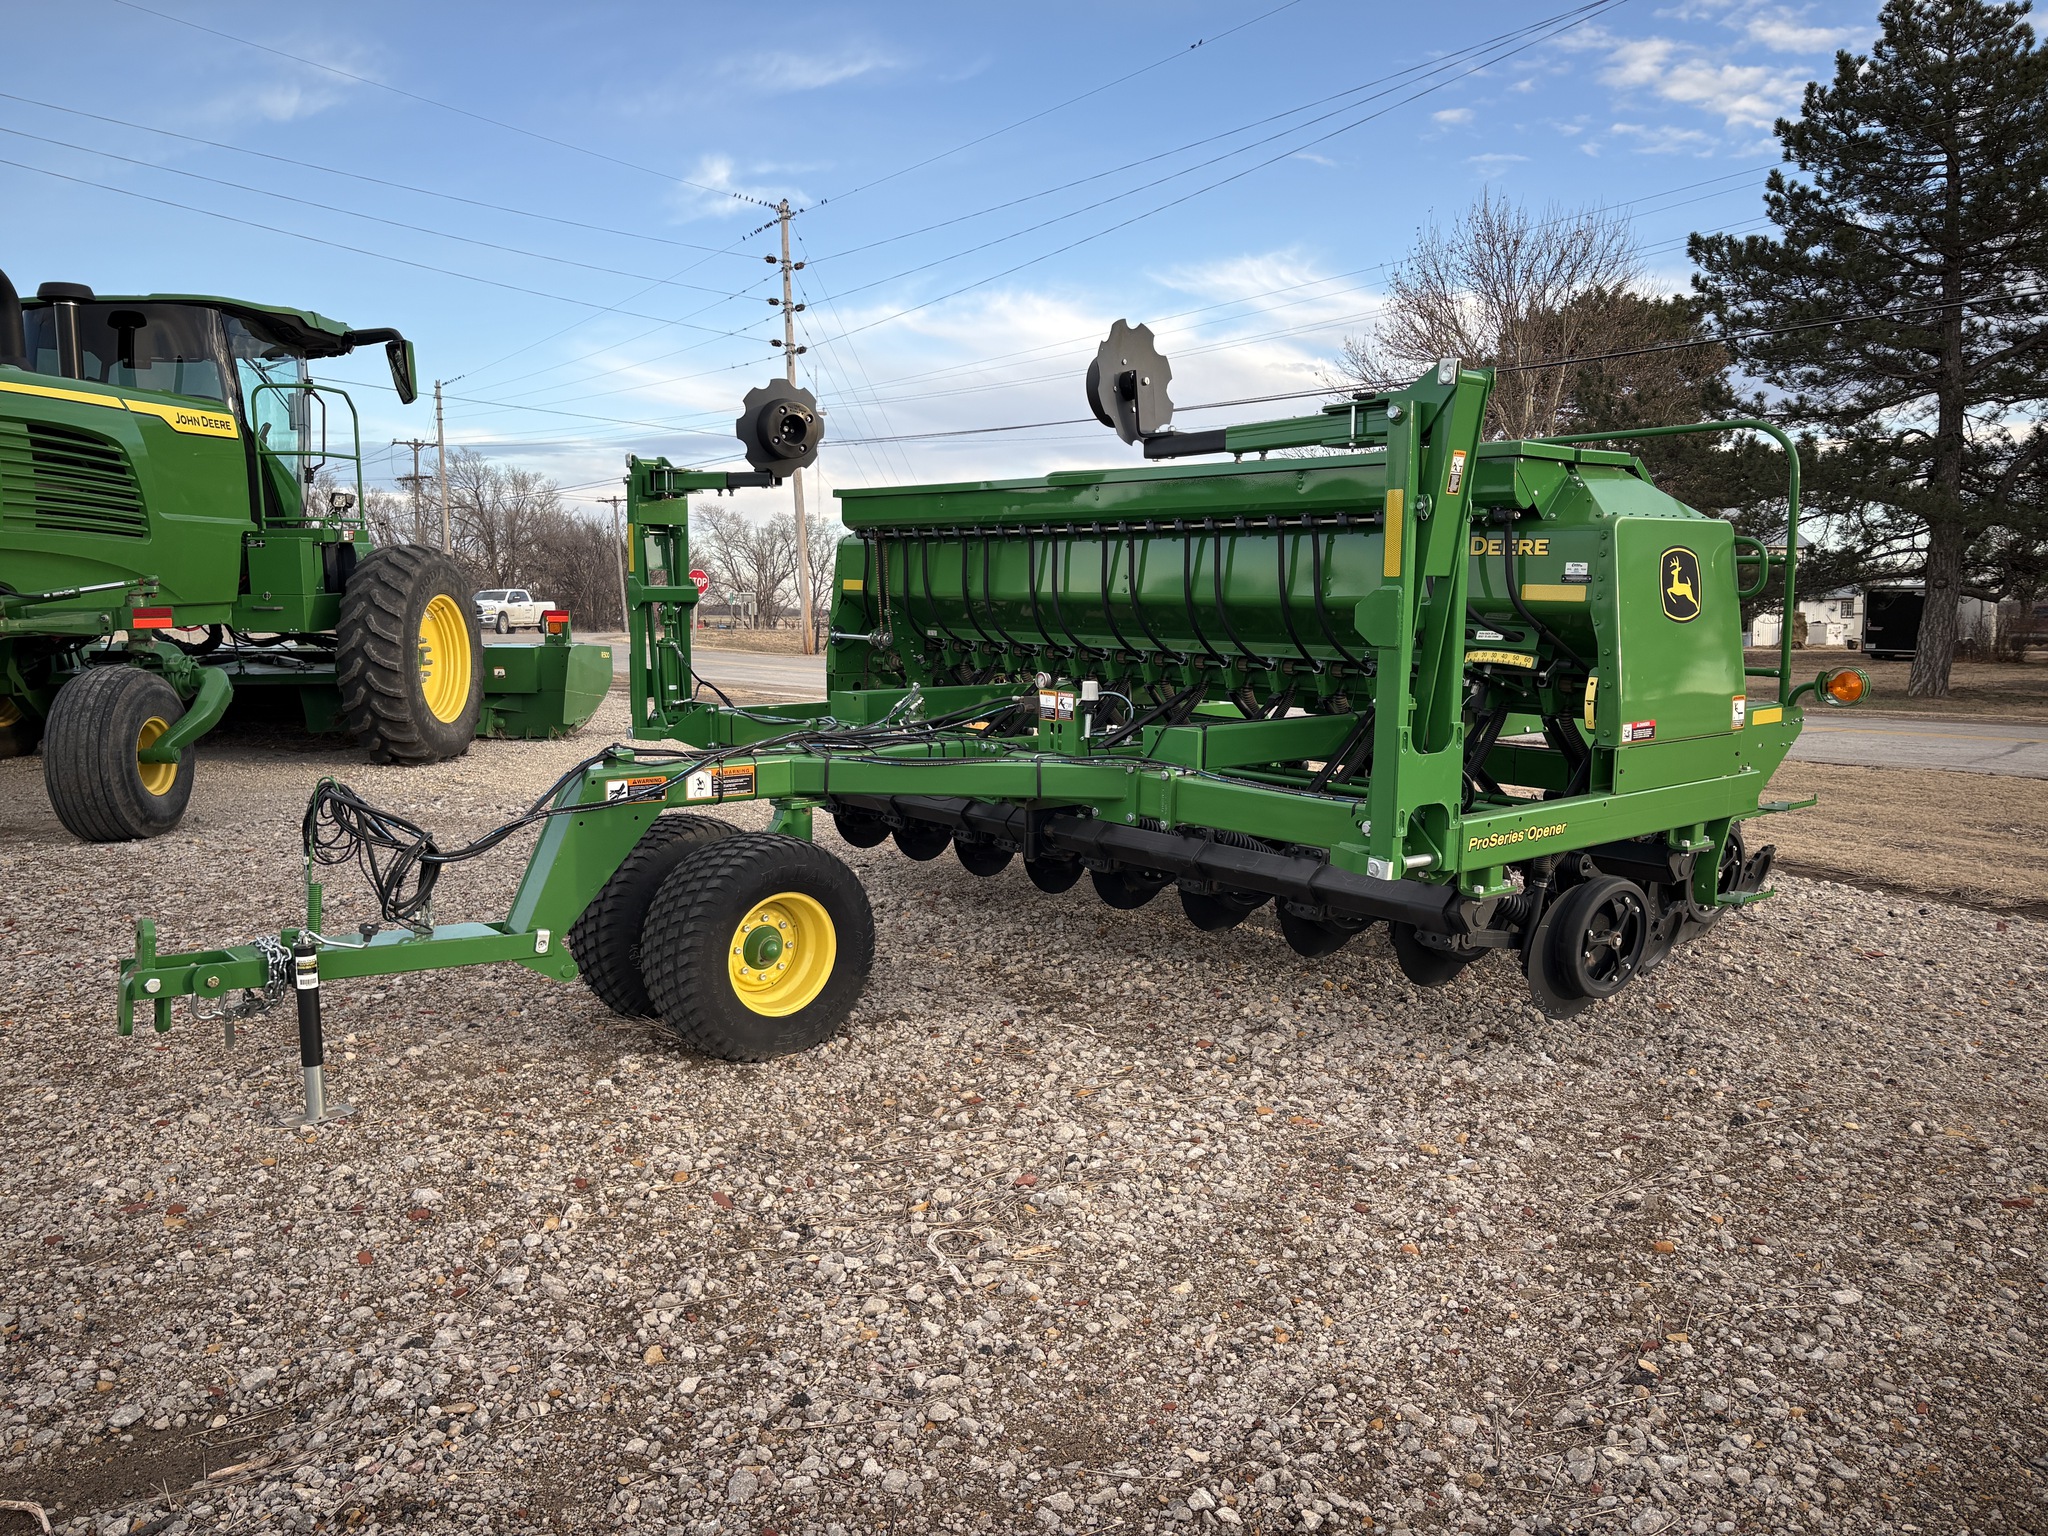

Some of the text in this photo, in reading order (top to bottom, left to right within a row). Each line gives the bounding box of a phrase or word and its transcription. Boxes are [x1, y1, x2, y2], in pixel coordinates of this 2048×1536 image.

[175, 412, 232, 431] JOHN DEERE
[692, 577, 708, 587] TOP
[636, 777, 662, 785] WARNING
[1527, 822, 1568, 842] Opener
